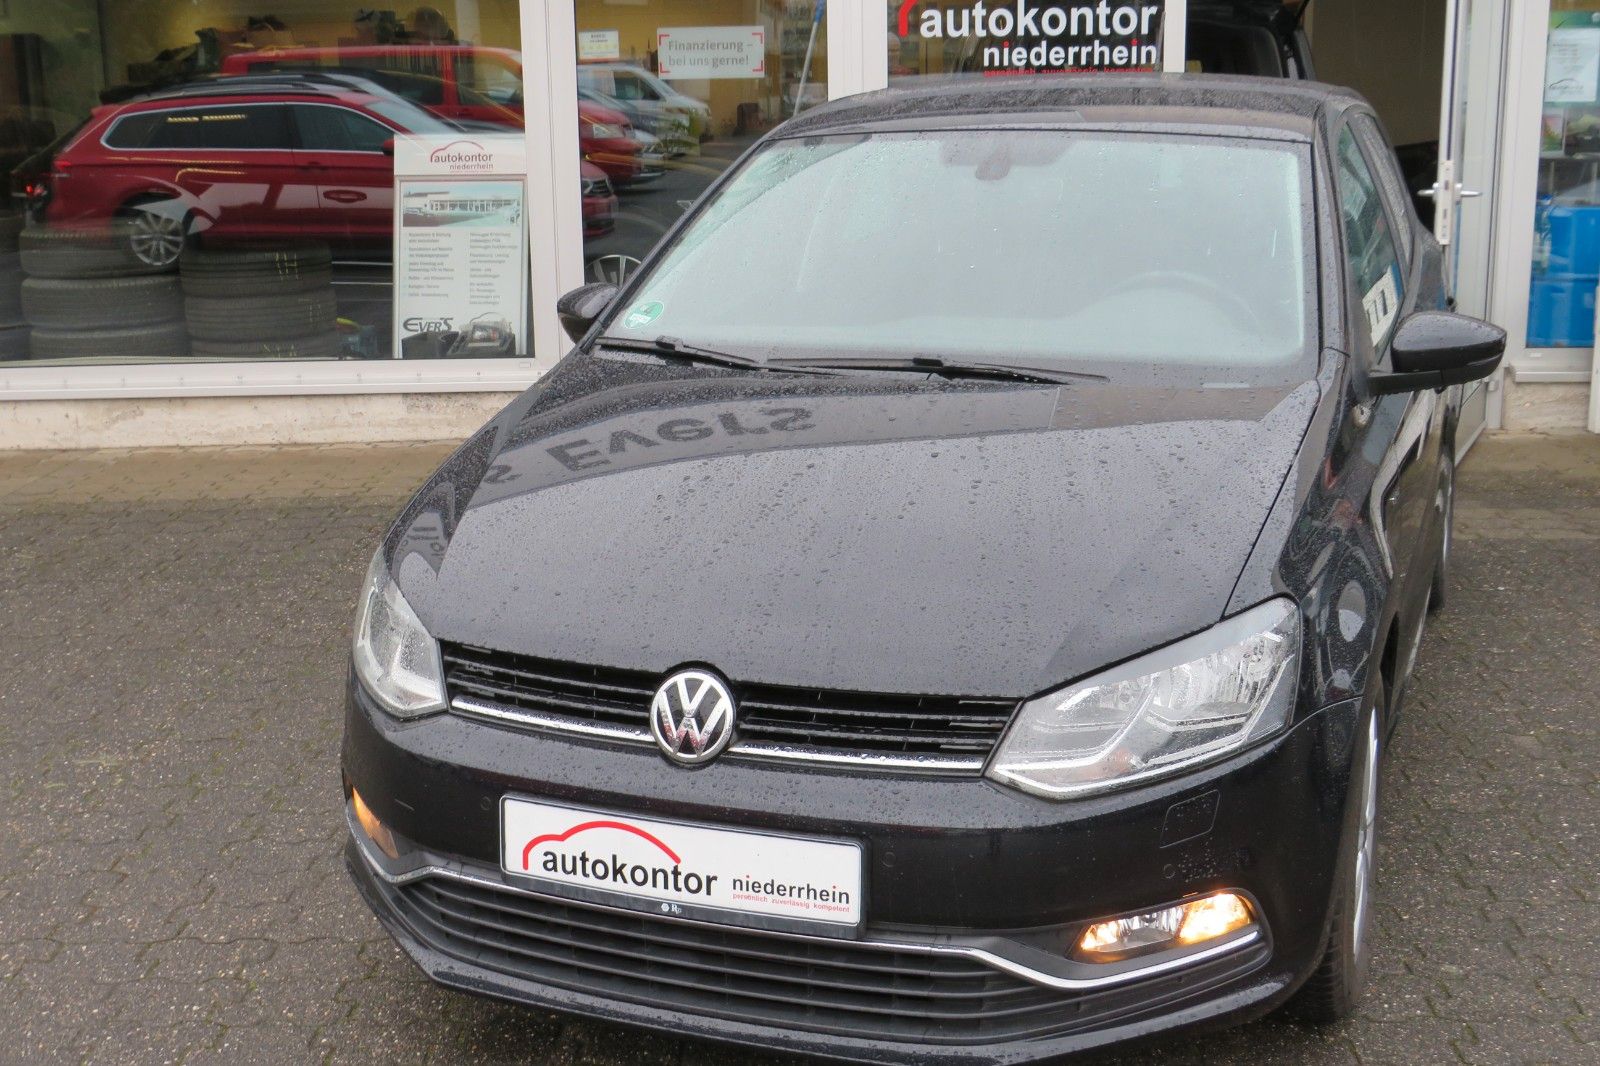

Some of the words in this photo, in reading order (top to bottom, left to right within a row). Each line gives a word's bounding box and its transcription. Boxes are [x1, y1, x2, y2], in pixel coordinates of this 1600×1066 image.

[920, 0, 1158, 38] autokontor
[668, 40, 743, 53] Finanzierung
[983, 38, 1157, 67] niederrhein
[668, 56, 686, 66] bei
[689, 58, 709, 66] uns
[712, 55, 749, 68] gerne!
[434, 152, 493, 163] autokontor
[449, 163, 494, 171] niederrhein
[542, 849, 719, 897] autokontor
[733, 875, 850, 905] niederrhein
[733, 893, 768, 903] persönlich
[771, 897, 810, 909] zuverlässig
[813, 903, 850, 913] kompetent
